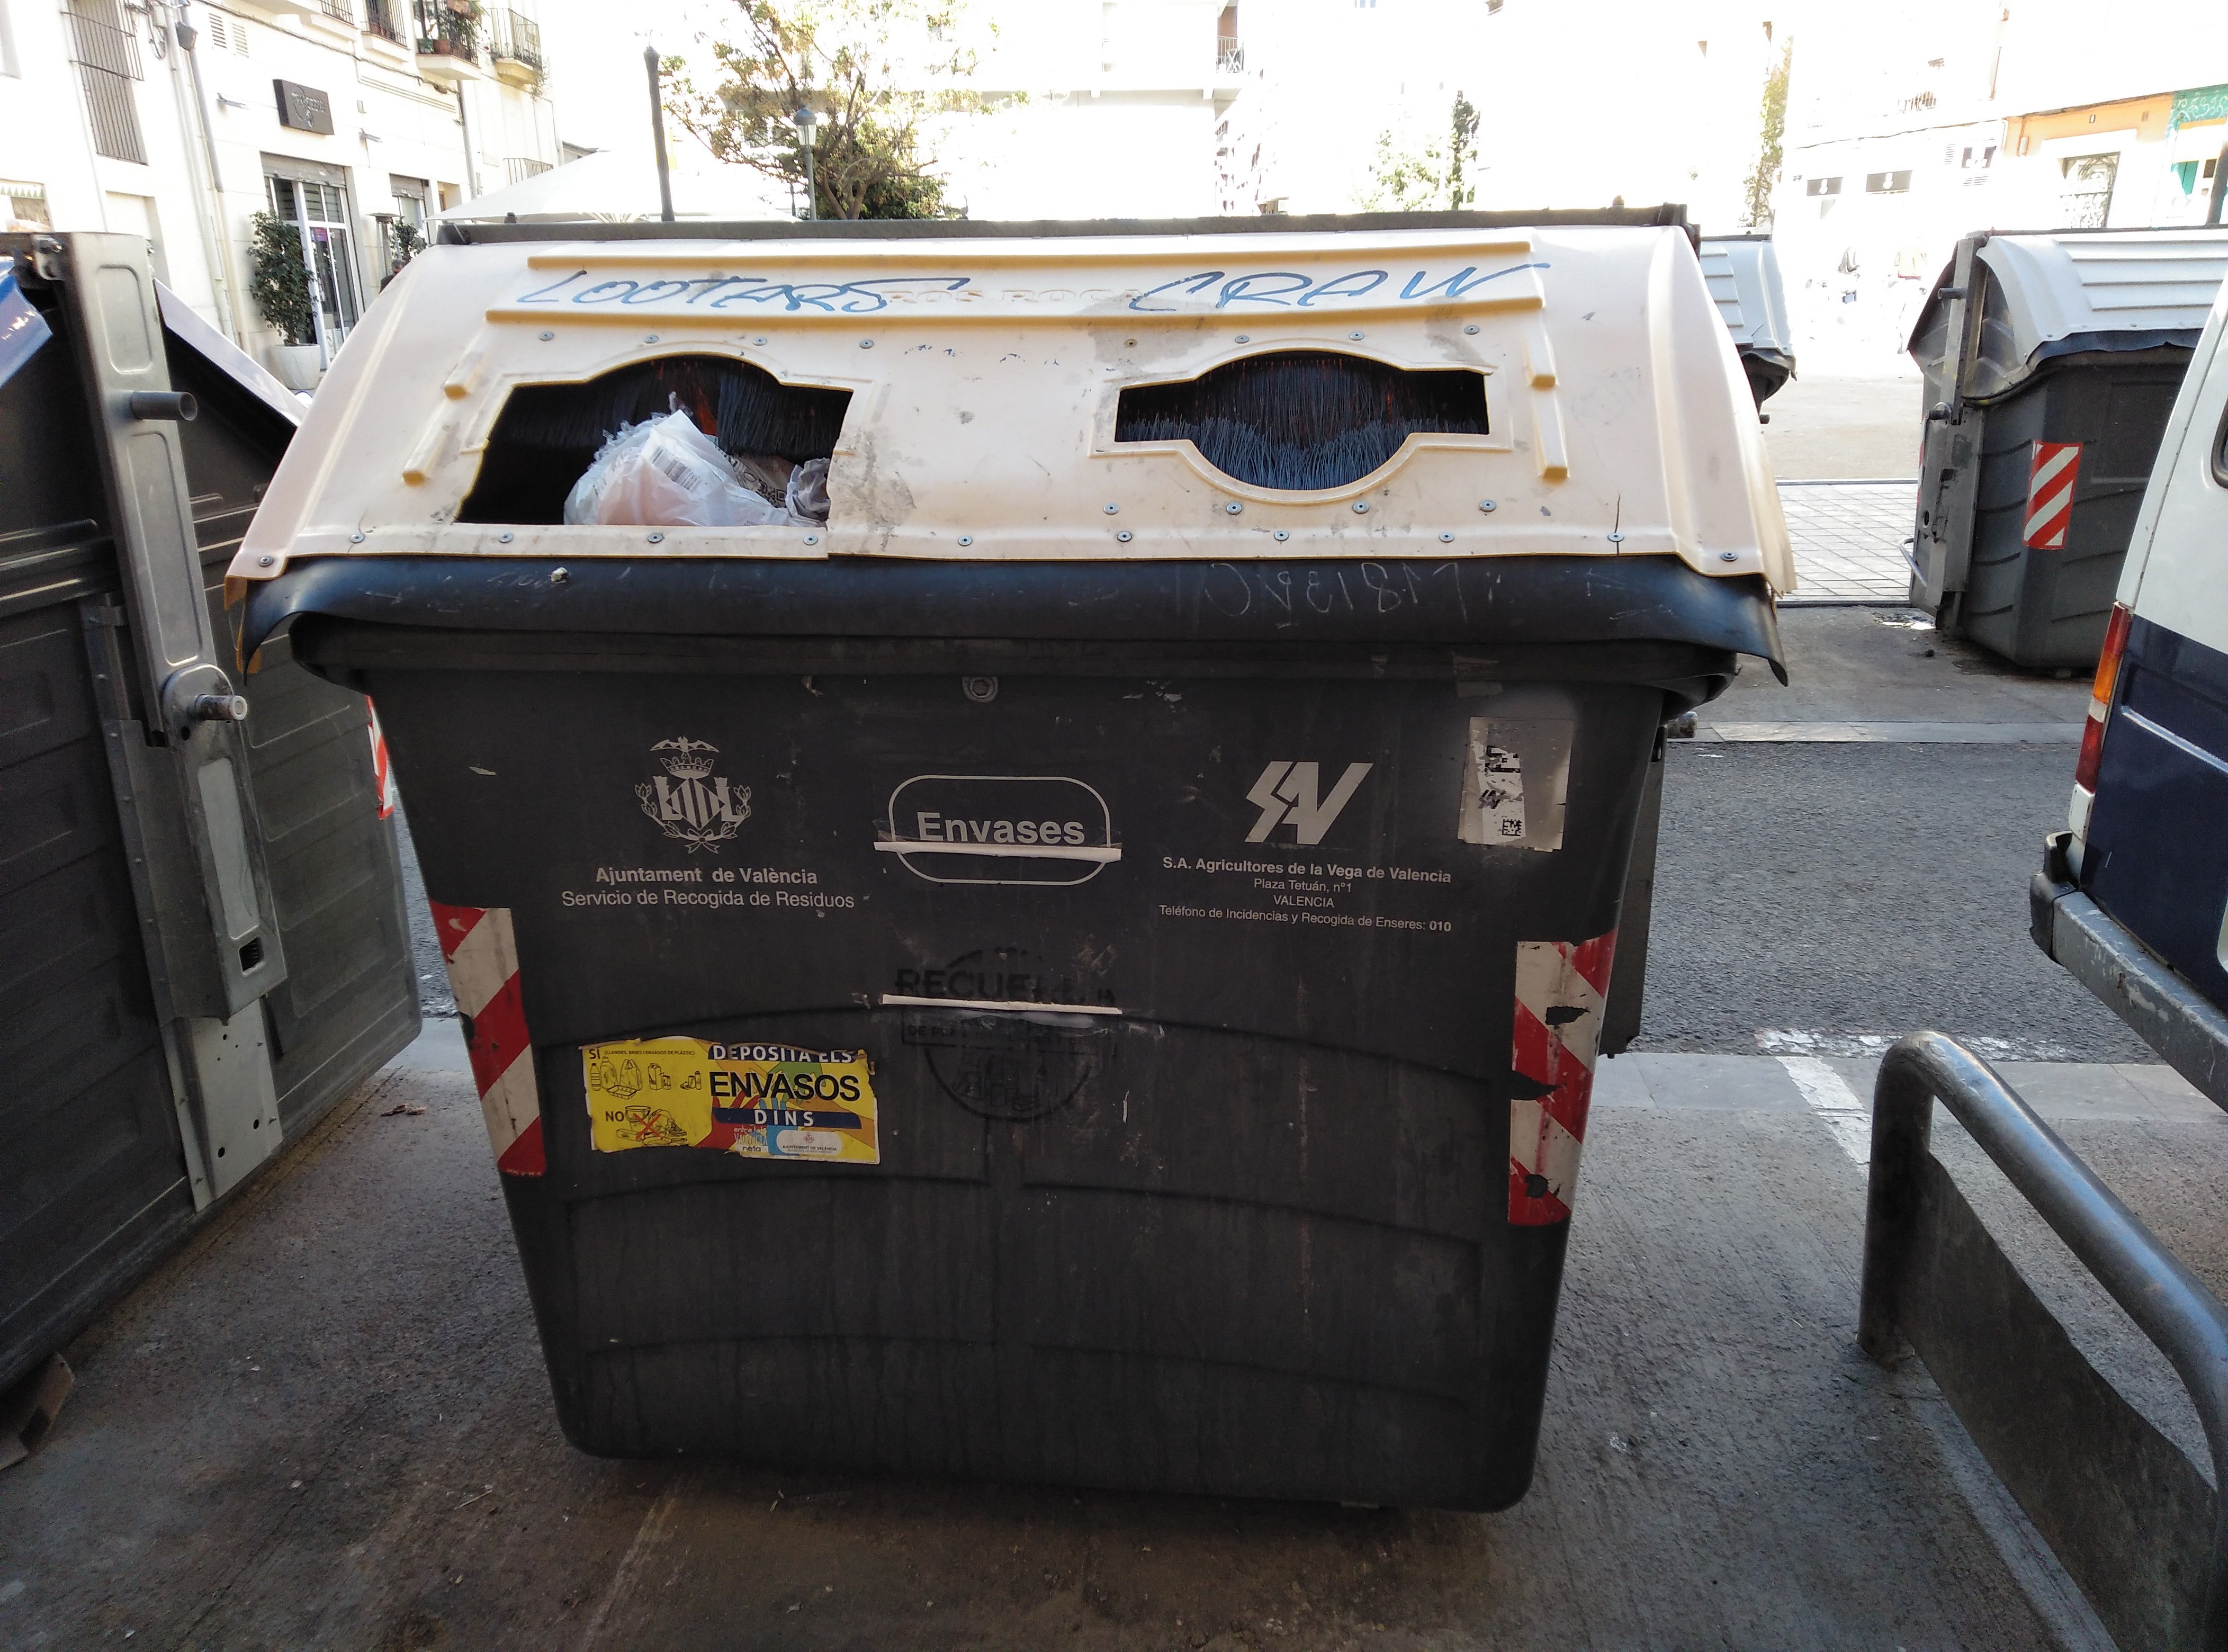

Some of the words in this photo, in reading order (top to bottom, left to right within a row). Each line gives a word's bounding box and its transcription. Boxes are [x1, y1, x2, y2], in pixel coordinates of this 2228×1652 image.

[917, 812, 1085, 845] Envases
[596, 867, 703, 886] Ajuntament
[712, 867, 735, 882] de
[739, 867, 817, 884] València
[1163, 856, 1192, 869] S.A.
[1195, 858, 1283, 874] Agricultores
[1288, 863, 1306, 874] de
[1310, 863, 1323, 875] la
[1327, 864, 1362, 879] Vega
[1367, 866, 1385, 878] de
[1389, 867, 1451, 883] Valencia
[1254, 878, 1285, 890] Plaza
[1288, 879, 1329, 893] Tetuán,
[562, 890, 632, 906] Servicio
[637, 890, 658, 904] de
[663, 890, 744, 909] Recogida
[749, 891, 770, 906] de
[776, 891, 855, 908] Residuos
[1273, 895, 1334, 908] VALENCIA
[1159, 904, 1206, 918] Teléfono
[1209, 908, 1223, 918] de
[1226, 908, 1288, 922] Incidencias
[1291, 914, 1298, 924] y
[1301, 912, 1354, 926] Recogida
[1358, 915, 1372, 927] de
[1376, 917, 1425, 930] Enseres:
[1429, 920, 1452, 932] 010
[713, 1045, 812, 1062] DEPOSITA
[709, 1071, 860, 1101] ENVASOS
[605, 1111, 624, 1122] NO
[754, 1110, 814, 1127] DINS
